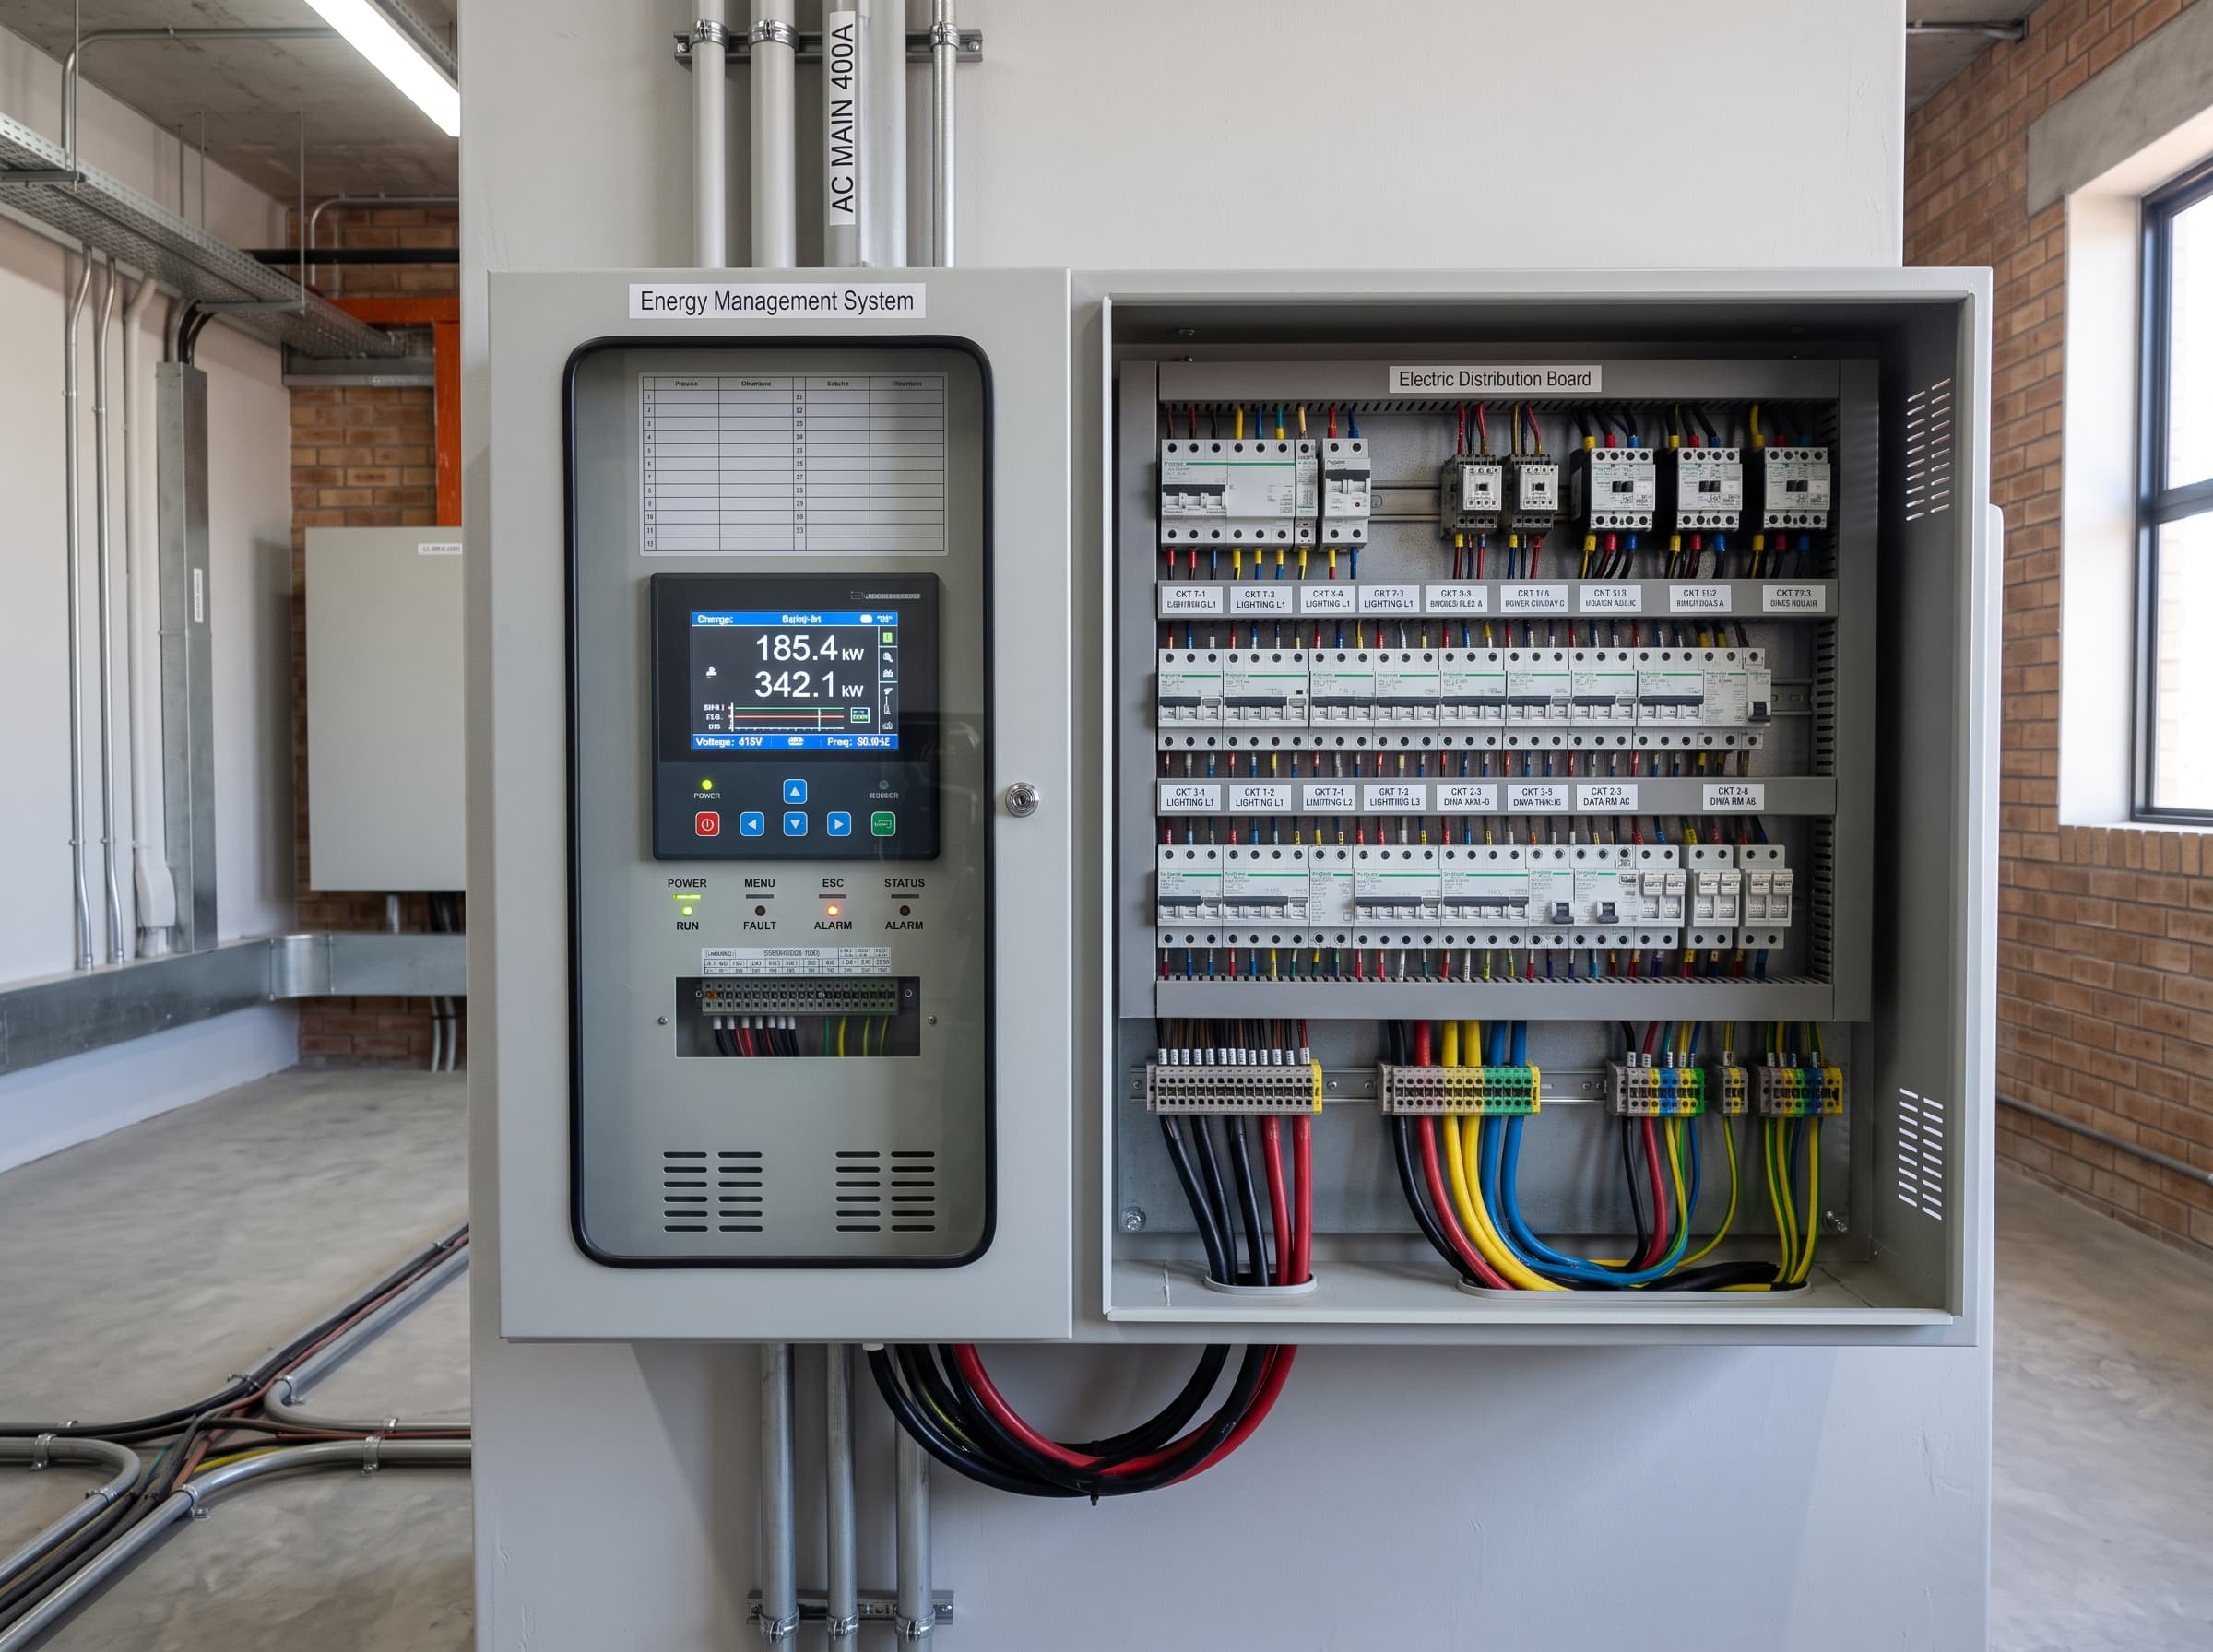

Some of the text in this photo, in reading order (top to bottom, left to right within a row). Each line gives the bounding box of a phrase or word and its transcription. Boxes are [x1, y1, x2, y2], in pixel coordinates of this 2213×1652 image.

[831, 24, 853, 213] AC MAIN 400A
[641, 289, 914, 315] Energy Management System
[1400, 371, 1591, 386] Electric Distribution Board
[756, 635, 865, 661] 185.4 kW
[754, 671, 864, 698] 342.1 kW
[1583, 797, 1604, 806] DATA
[1605, 797, 1617, 806] RM
[668, 879, 707, 888] POWER
[744, 879, 775, 888] MENU
[822, 879, 844, 888] ESC
[884, 879, 925, 888] STATUS
[676, 921, 699, 930] RUN
[743, 921, 776, 930] FAULT
[814, 921, 852, 930] ALARM
[885, 921, 923, 930] ALARM
